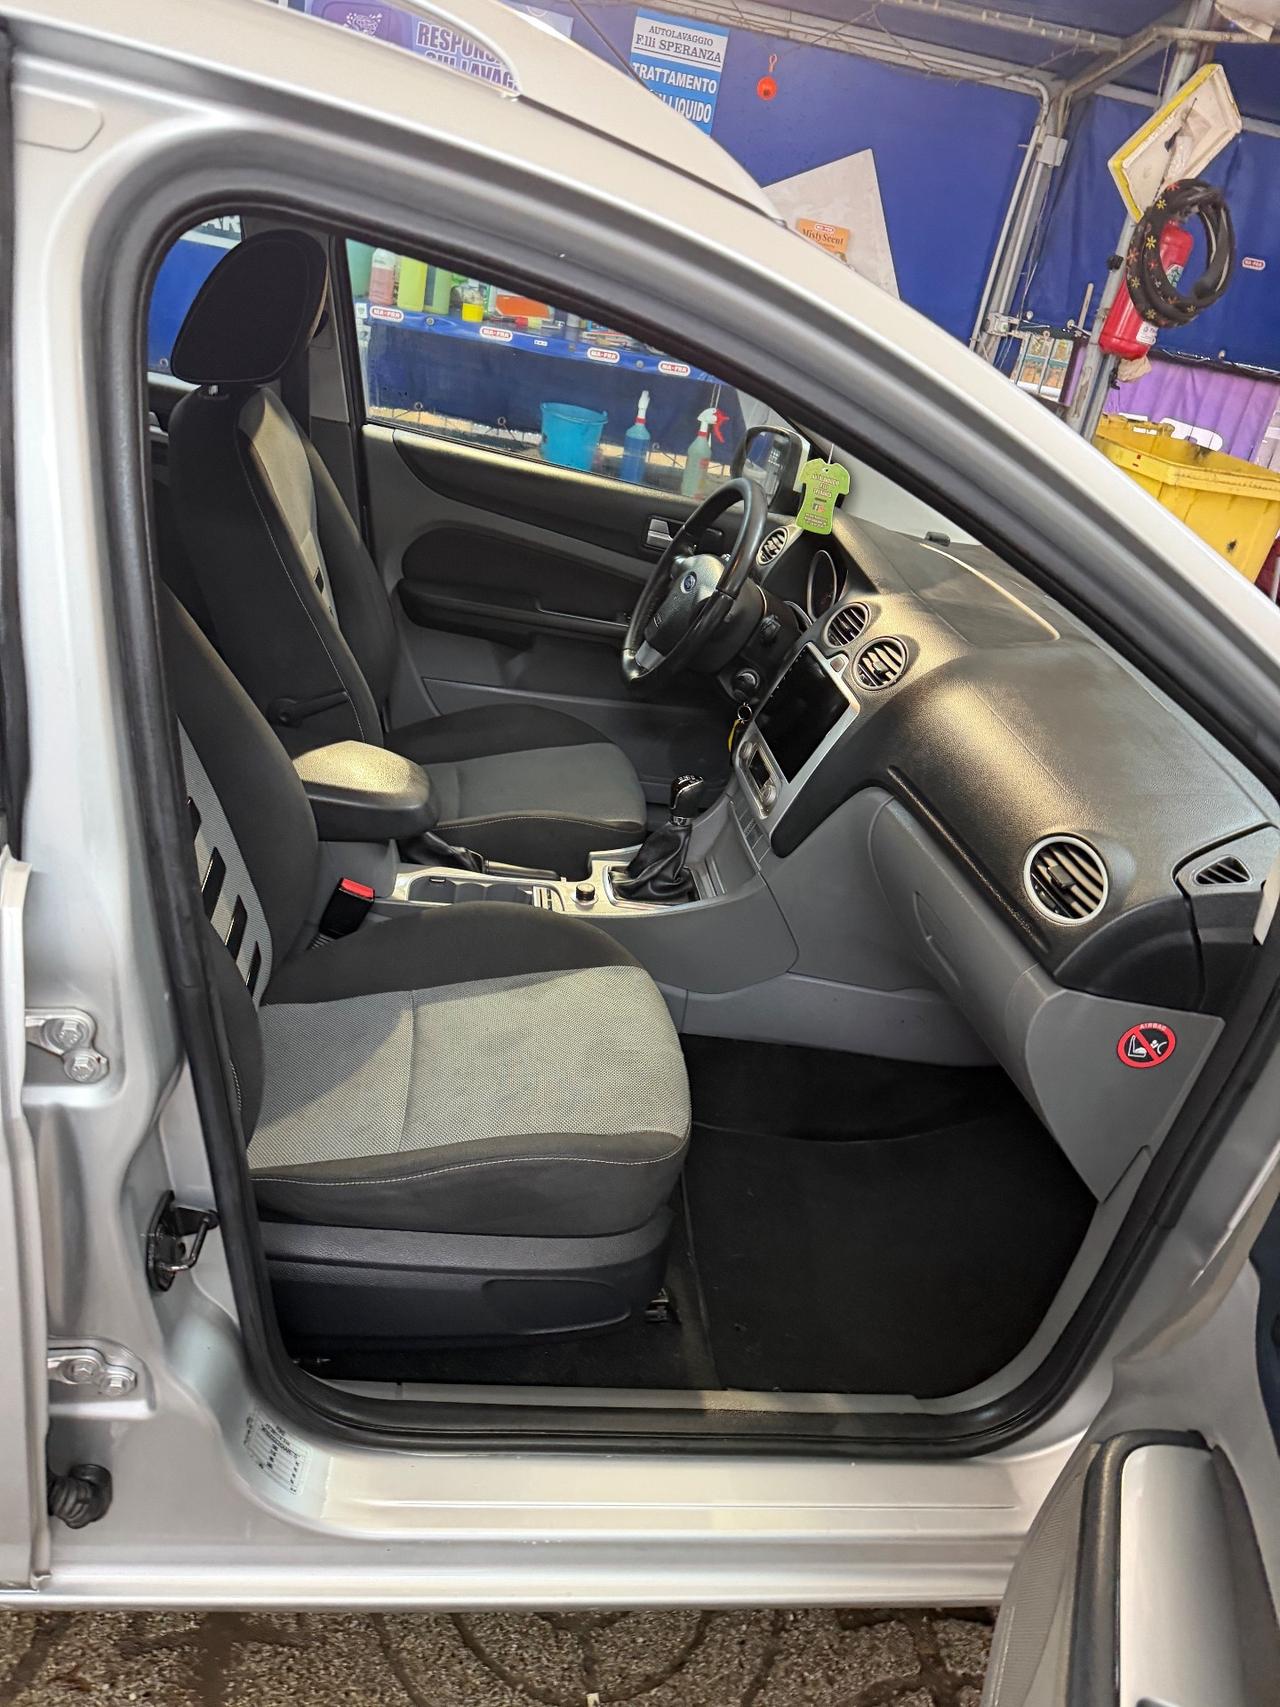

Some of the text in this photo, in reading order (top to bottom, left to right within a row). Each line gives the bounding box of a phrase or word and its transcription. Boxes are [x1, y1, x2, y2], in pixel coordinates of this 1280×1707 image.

[649, 25, 714, 47] AUTOLAVAGGIO
[658, 39, 723, 63] SPERANZA
[631, 62, 718, 94] TRATTAMENTO
[1139, 1023, 1167, 1031] AIRBAG
